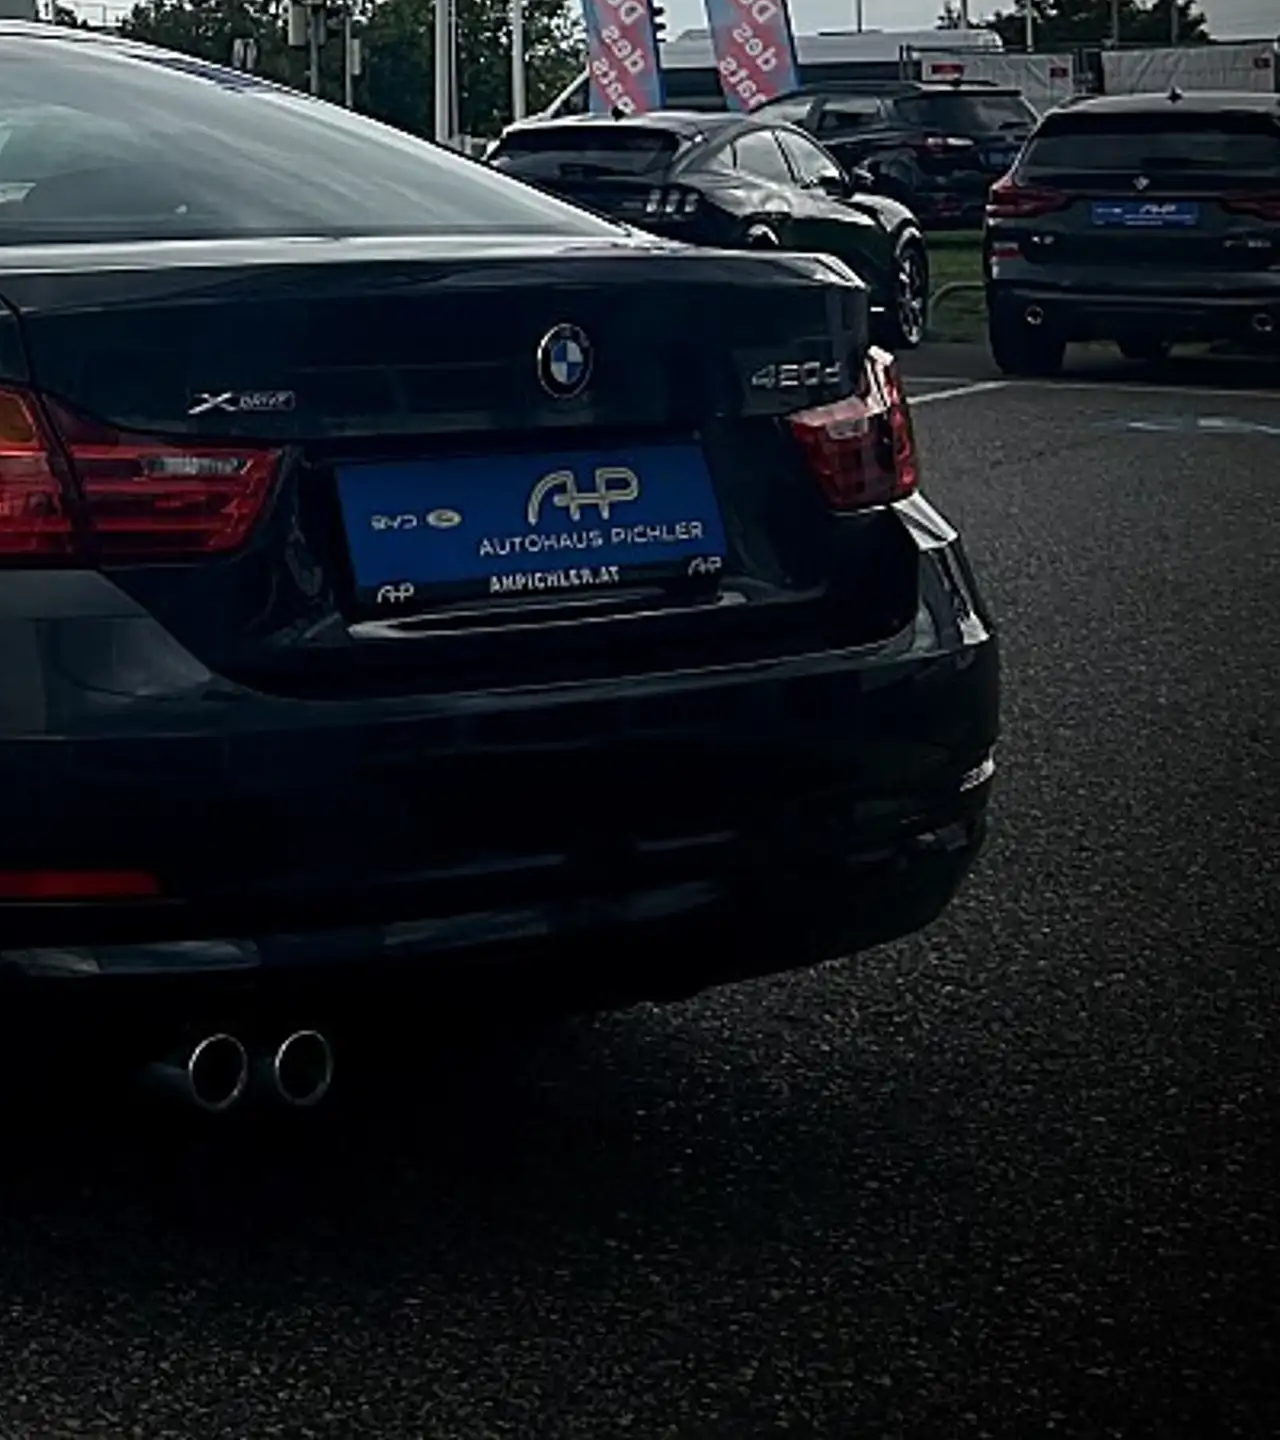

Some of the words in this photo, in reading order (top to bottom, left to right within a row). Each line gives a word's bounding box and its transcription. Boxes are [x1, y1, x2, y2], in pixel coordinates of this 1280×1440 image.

[749, 359, 843, 390] 420d
[526, 464, 641, 527] AHP
[478, 527, 605, 558] AUTOHAUS
[610, 519, 706, 546] PICHLER
[488, 563, 621, 595] AHPICHLER.AT
